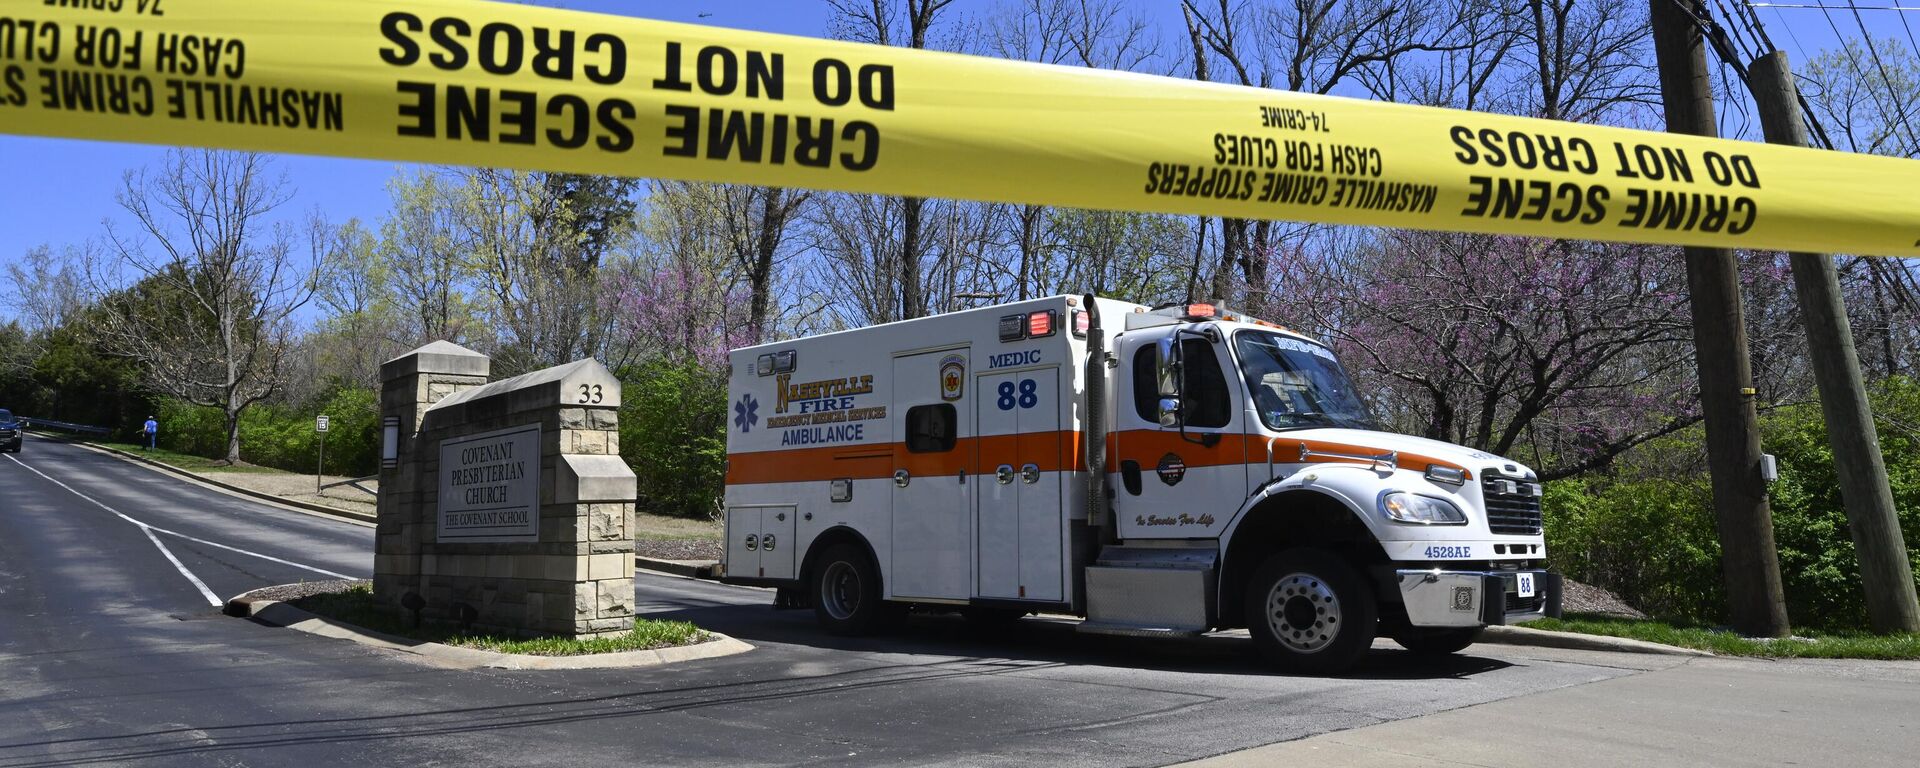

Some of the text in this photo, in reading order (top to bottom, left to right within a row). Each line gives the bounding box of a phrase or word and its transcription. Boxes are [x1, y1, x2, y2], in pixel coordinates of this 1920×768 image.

[73, 25, 142, 71] FOR
[156, 33, 245, 80] CASH
[379, 12, 895, 111] DO NOT CROSS
[37, 67, 154, 117] CRIME
[165, 78, 344, 132] NASHVILLE
[396, 80, 880, 172] CRIME SCENE
[1259, 106, 1330, 132] 74-CRIME
[1214, 133, 1382, 178] CASH FOR CLUES
[1450, 126, 1761, 189] DO NOT CROSS
[1144, 162, 1438, 213] NASHVILLE CRIME STOPPERS
[1460, 175, 1757, 235] CRIME SCENE
[989, 350, 1041, 369] MEDIC
[578, 384, 603, 404] 33
[800, 397, 855, 413] FIRE
[997, 379, 1038, 411] 88
[781, 424, 864, 446] AMBULANCE
[462, 441, 514, 465] COVENANT
[451, 461, 525, 486] PRESBYTERIAN
[466, 486, 507, 505] CHURCH
[446, 511, 529, 526] THE COVENANT SCHOOL
[1424, 546, 1471, 558] 4528AE
[1521, 577, 1531, 593] 88
